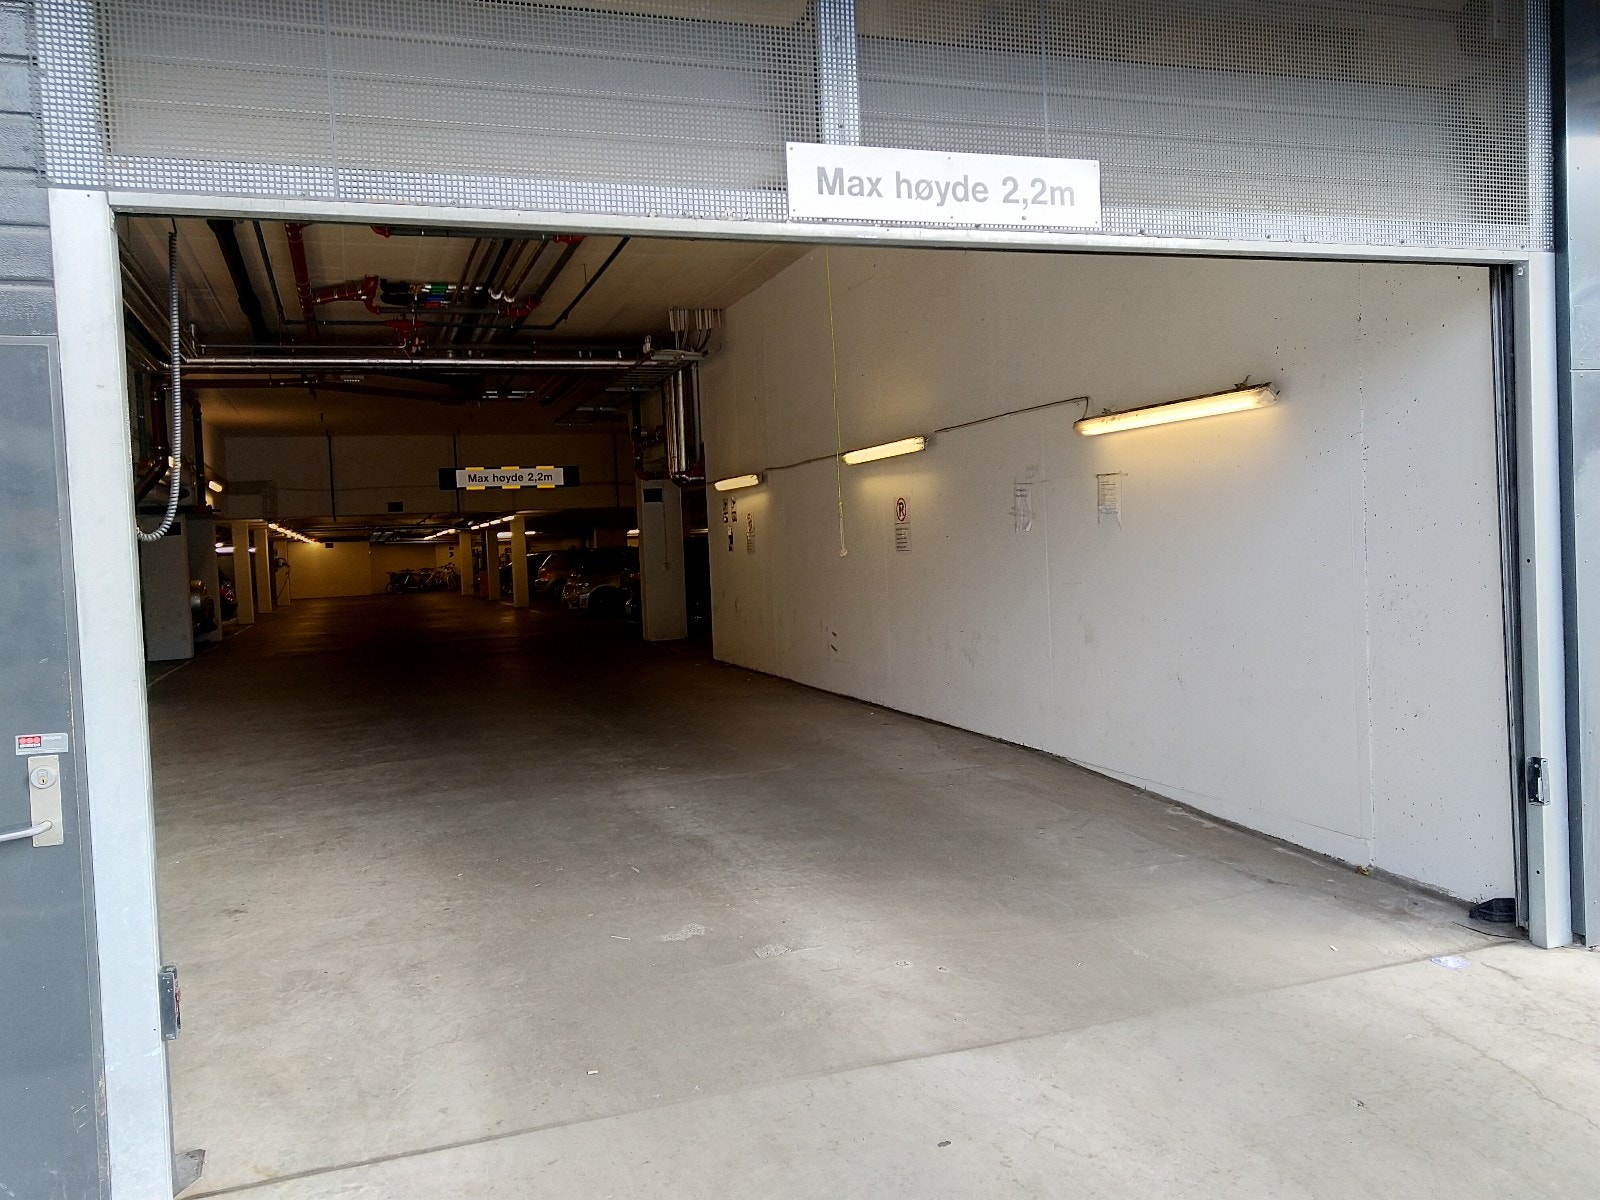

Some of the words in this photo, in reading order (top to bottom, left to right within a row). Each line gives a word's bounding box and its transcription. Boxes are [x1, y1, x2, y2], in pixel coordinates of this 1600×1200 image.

[816, 166, 883, 198] Max
[895, 171, 989, 207] høyde
[1002, 176, 1075, 210] 2,2m
[468, 474, 489, 483] Max
[492, 473, 524, 483] høyde
[527, 472, 553, 482] 2,2m
